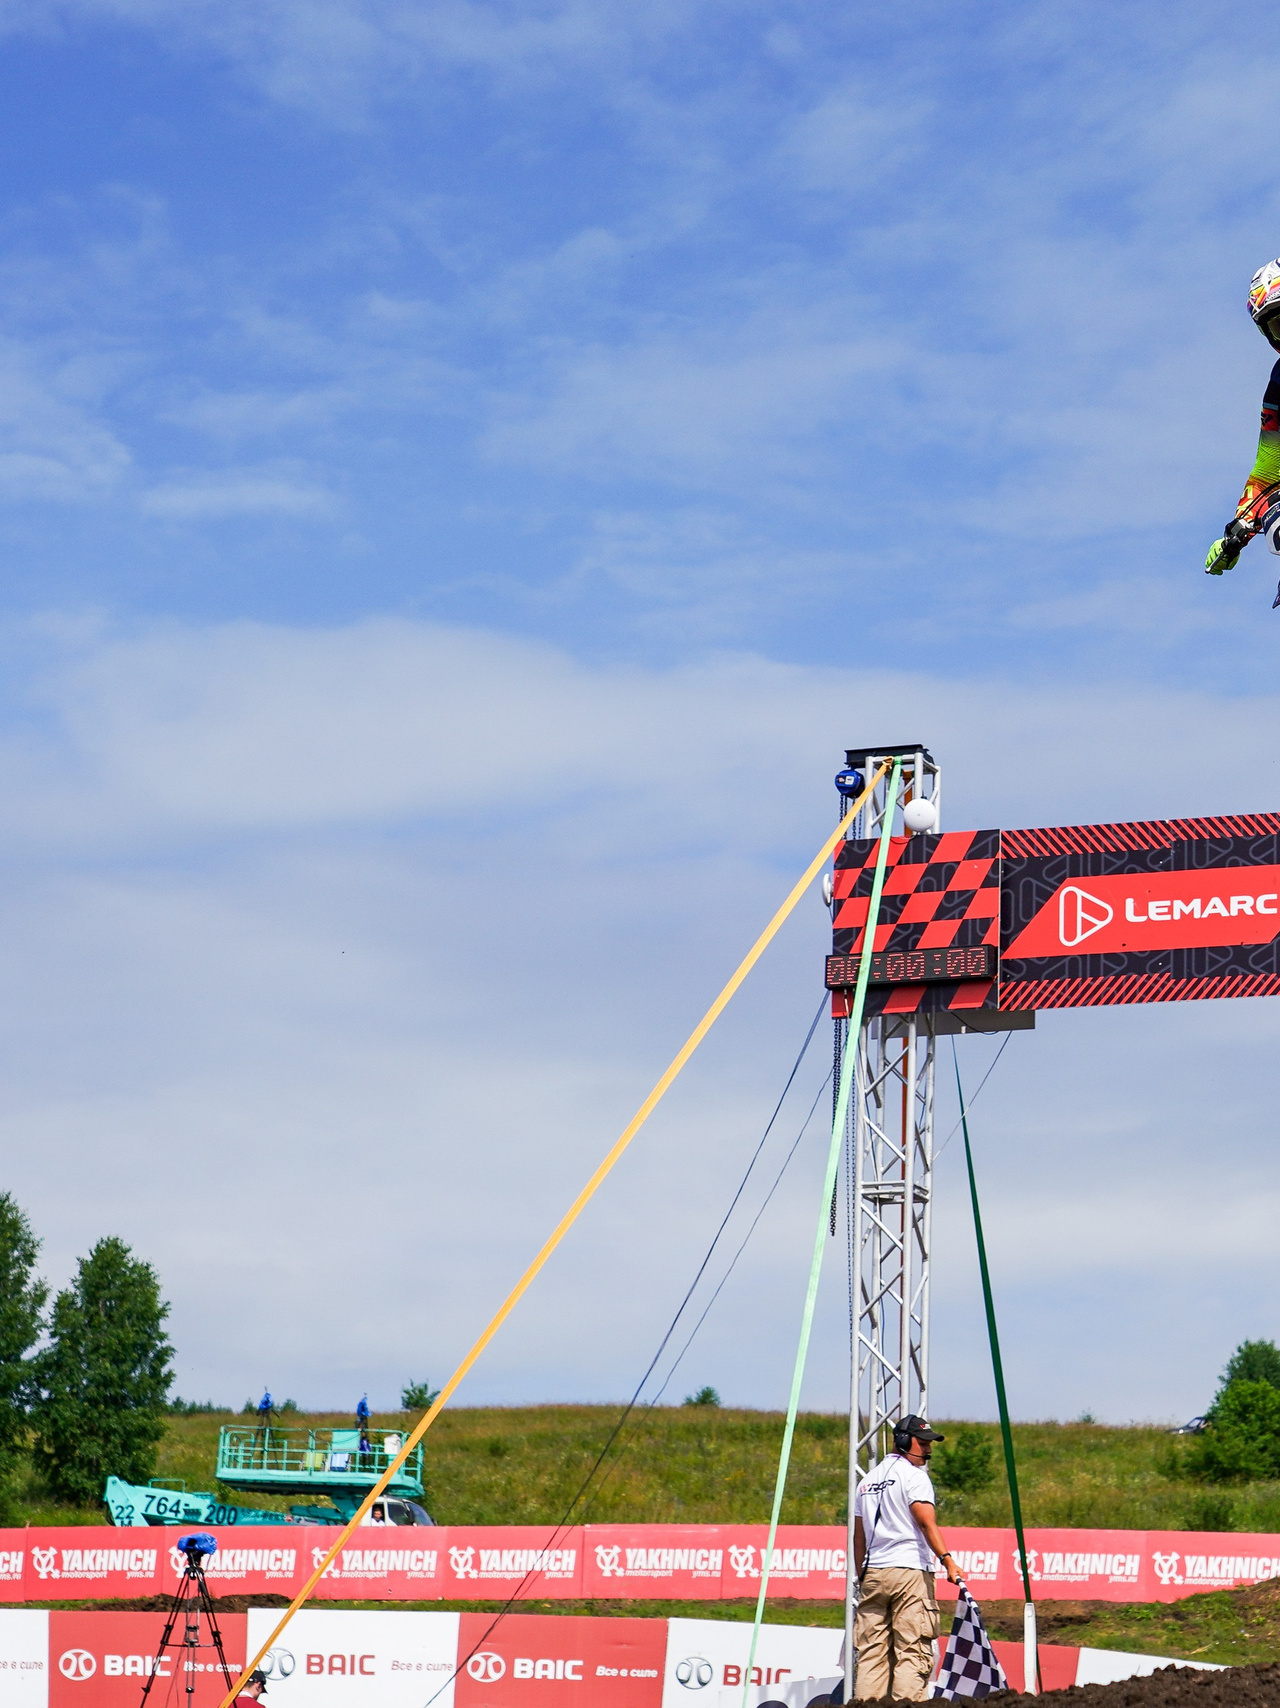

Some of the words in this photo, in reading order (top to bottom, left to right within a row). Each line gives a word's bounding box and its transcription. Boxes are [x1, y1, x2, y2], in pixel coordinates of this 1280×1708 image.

[115, 1505, 134, 1520] 22
[61, 1549, 157, 1571] YAKHNICH
[341, 1549, 437, 1571] YAKHNICH
[479, 1549, 576, 1571] YAKHNICH
[625, 1548, 723, 1570] YAKHNICH
[760, 1549, 847, 1571] YAKHNIC
[1042, 1552, 1140, 1575] YAKHNICH
[104, 1655, 171, 1677] BAIC
[306, 1654, 375, 1675] BAIC
[513, 1658, 583, 1680] BAIC
